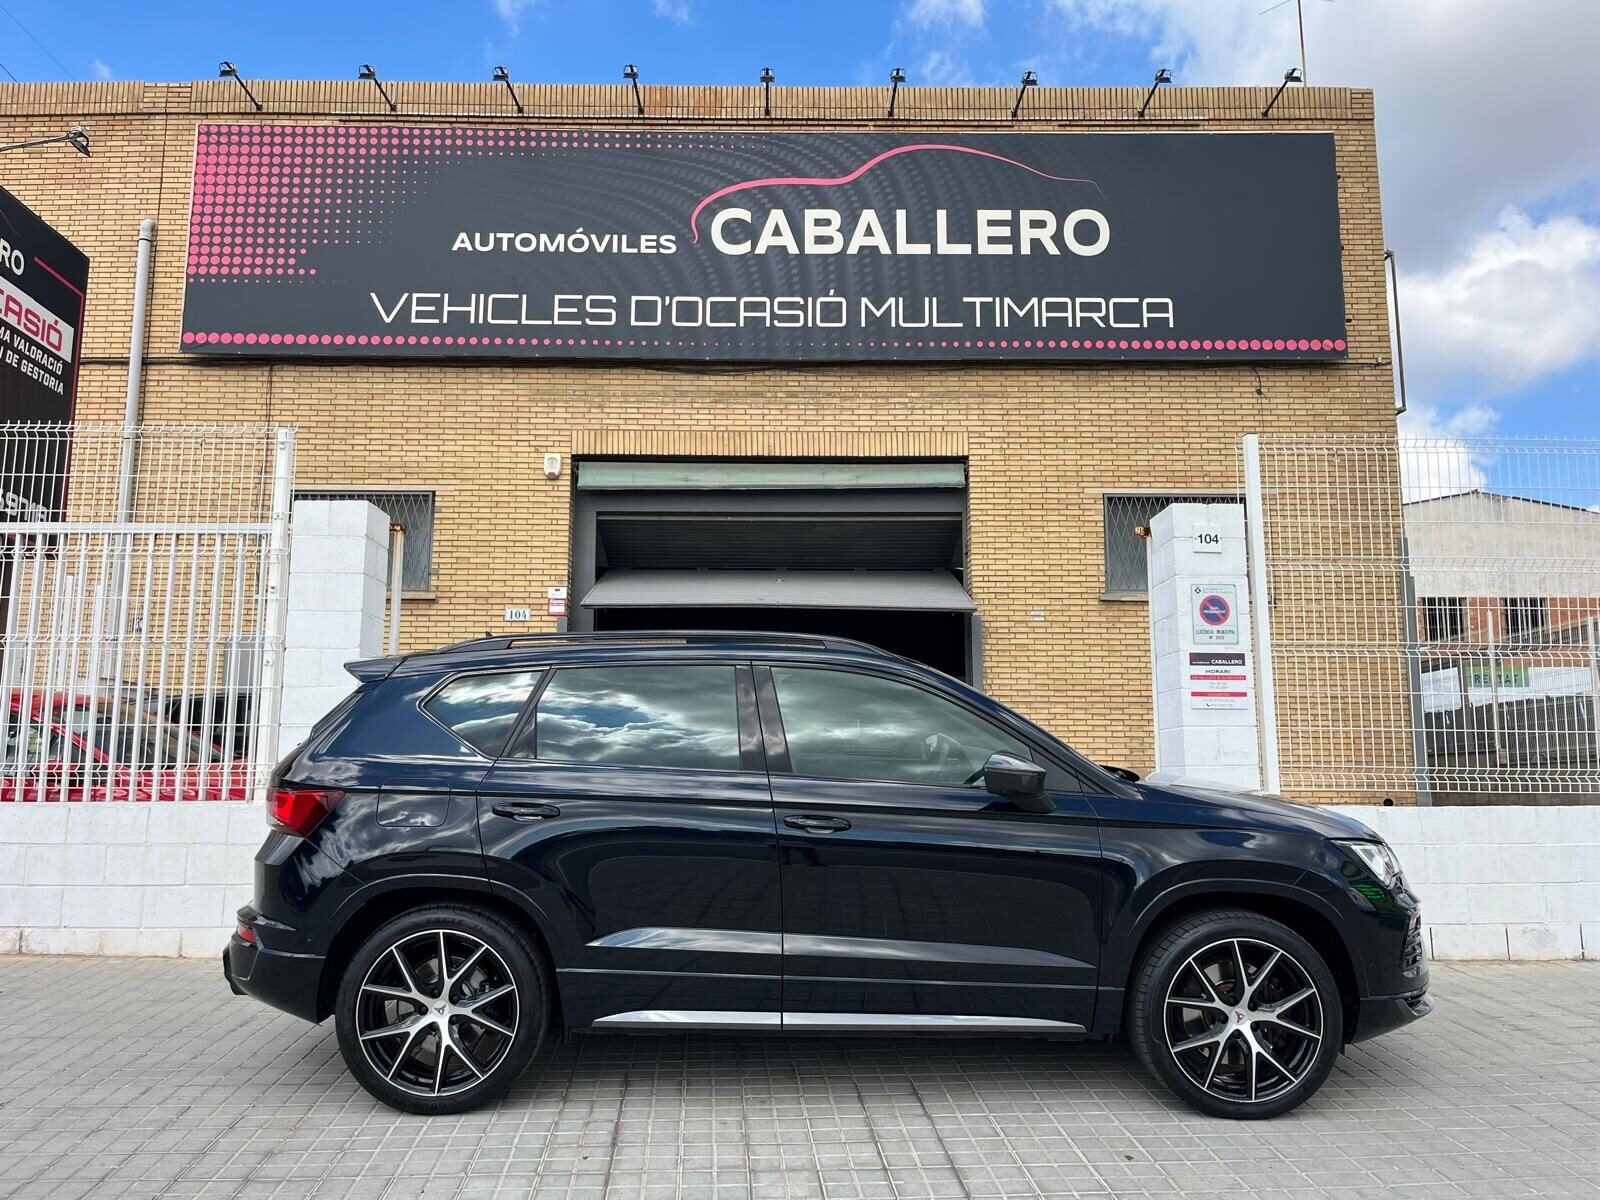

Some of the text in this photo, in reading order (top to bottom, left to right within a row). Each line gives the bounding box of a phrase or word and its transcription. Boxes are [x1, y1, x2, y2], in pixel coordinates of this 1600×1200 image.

[452, 208, 1110, 256] AUTOMÓVILES CABALLERO
[0, 288, 63, 352] ASIÓ
[370, 288, 1174, 328] VEHICLES D'OCASIÓ MULTIMARCA
[5, 349, 20, 368] DE
[21, 358, 64, 395] GESTORIA
[13, 334, 63, 376] VALORACIÓ
[1197, 533, 1219, 544] 104
[509, 610, 527, 619] 104
